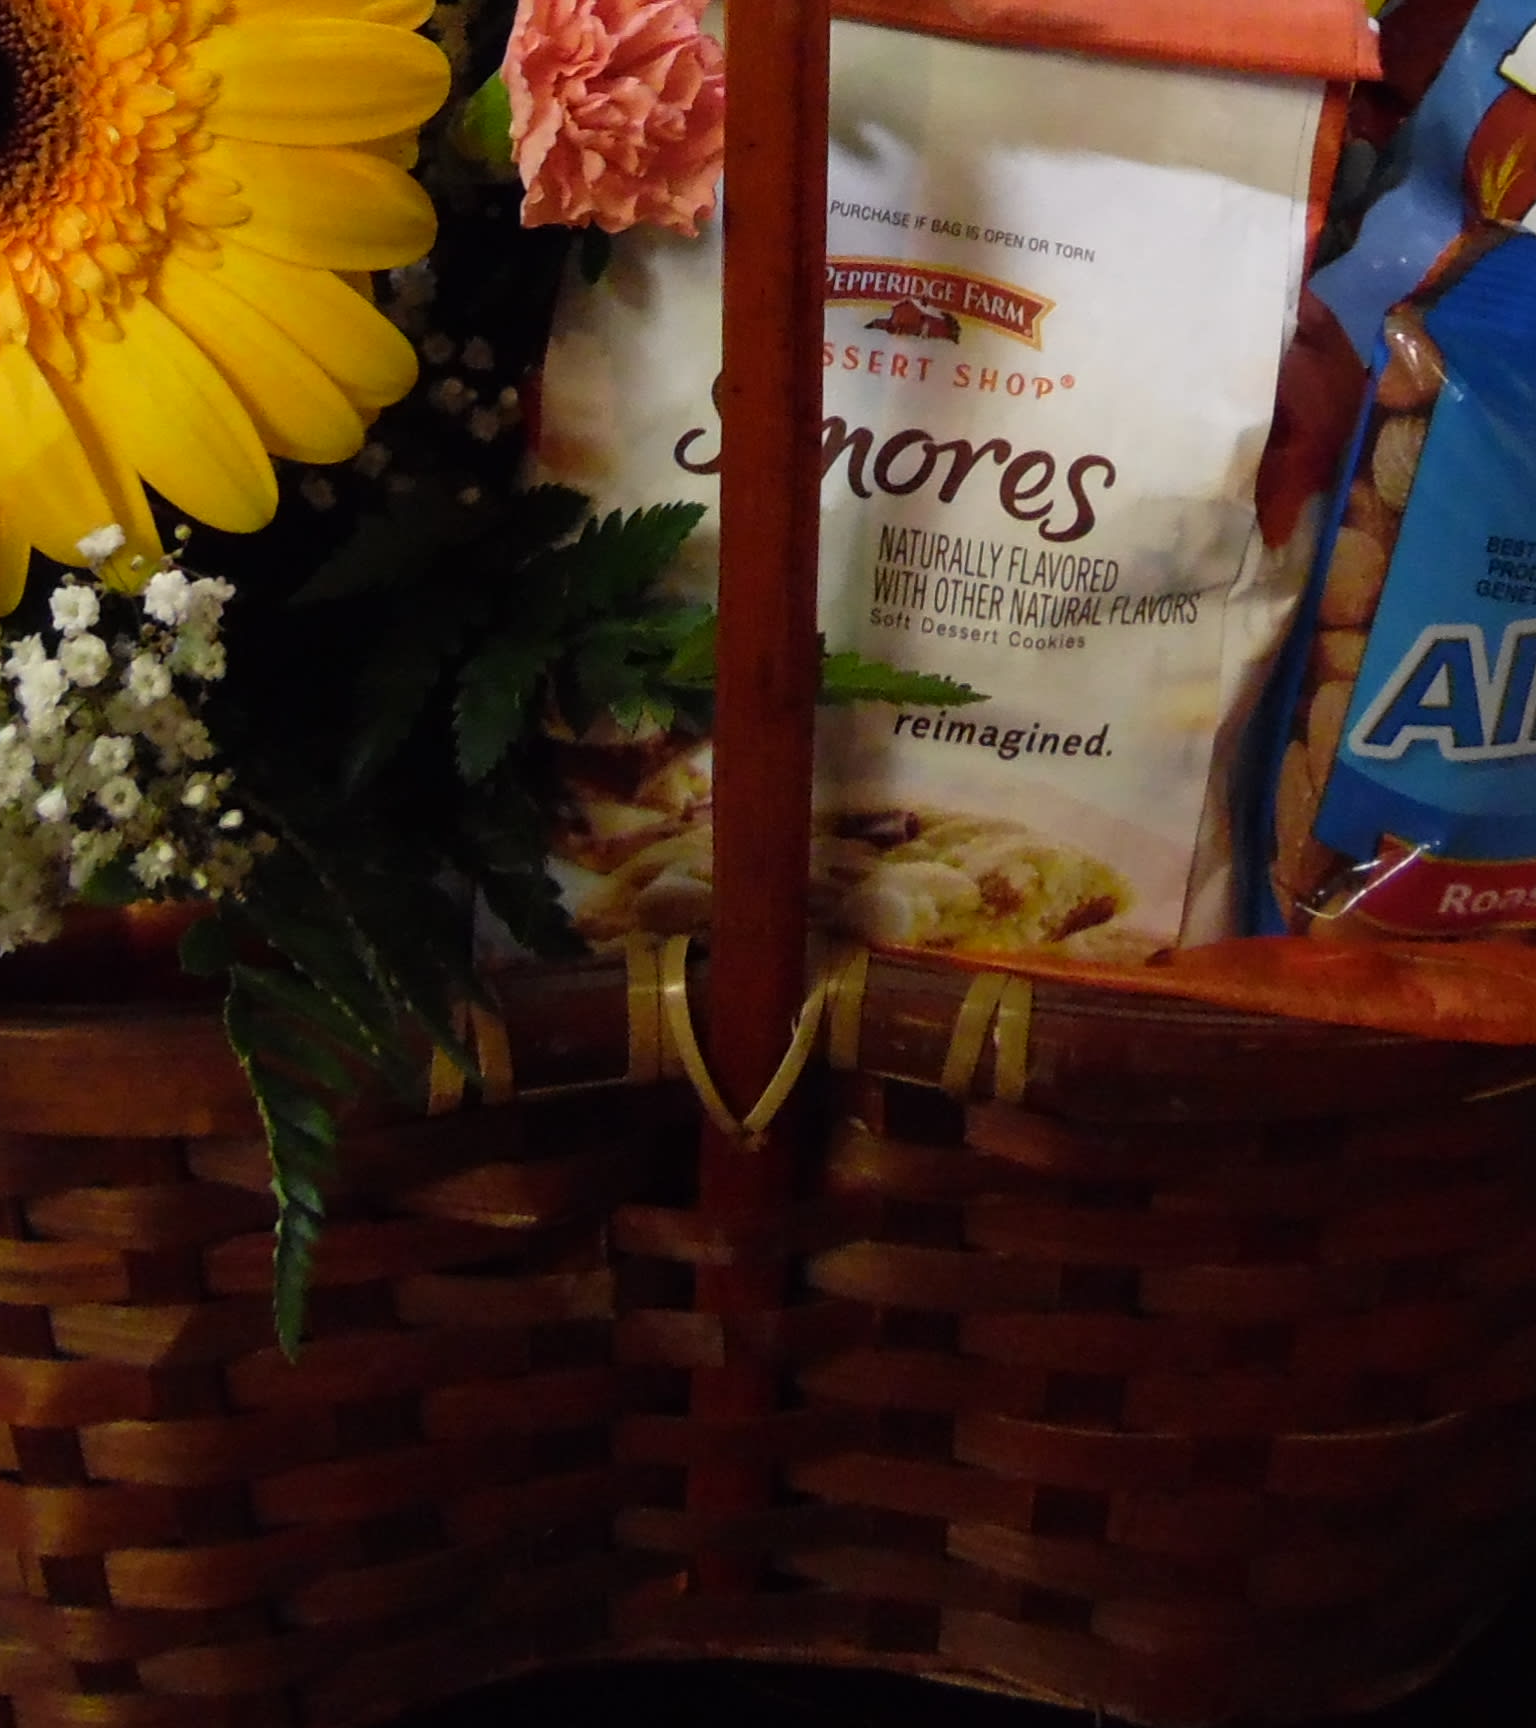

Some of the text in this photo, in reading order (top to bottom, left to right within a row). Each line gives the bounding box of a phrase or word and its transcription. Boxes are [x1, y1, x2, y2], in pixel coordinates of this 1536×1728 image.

[829, 199, 1097, 264] PURCHASE IF BAG IS OPEN OR TORN
[963, 281, 1026, 327] FARM
[822, 341, 934, 382] SSERT
[878, 524, 1119, 593] NATURALLY FLAVORED
[873, 566, 1202, 629] WITH OTHER NATURAL FLAVORS
[869, 609, 1087, 651] Soft Dessert Cookies
[893, 710, 1114, 761] reimagined.
